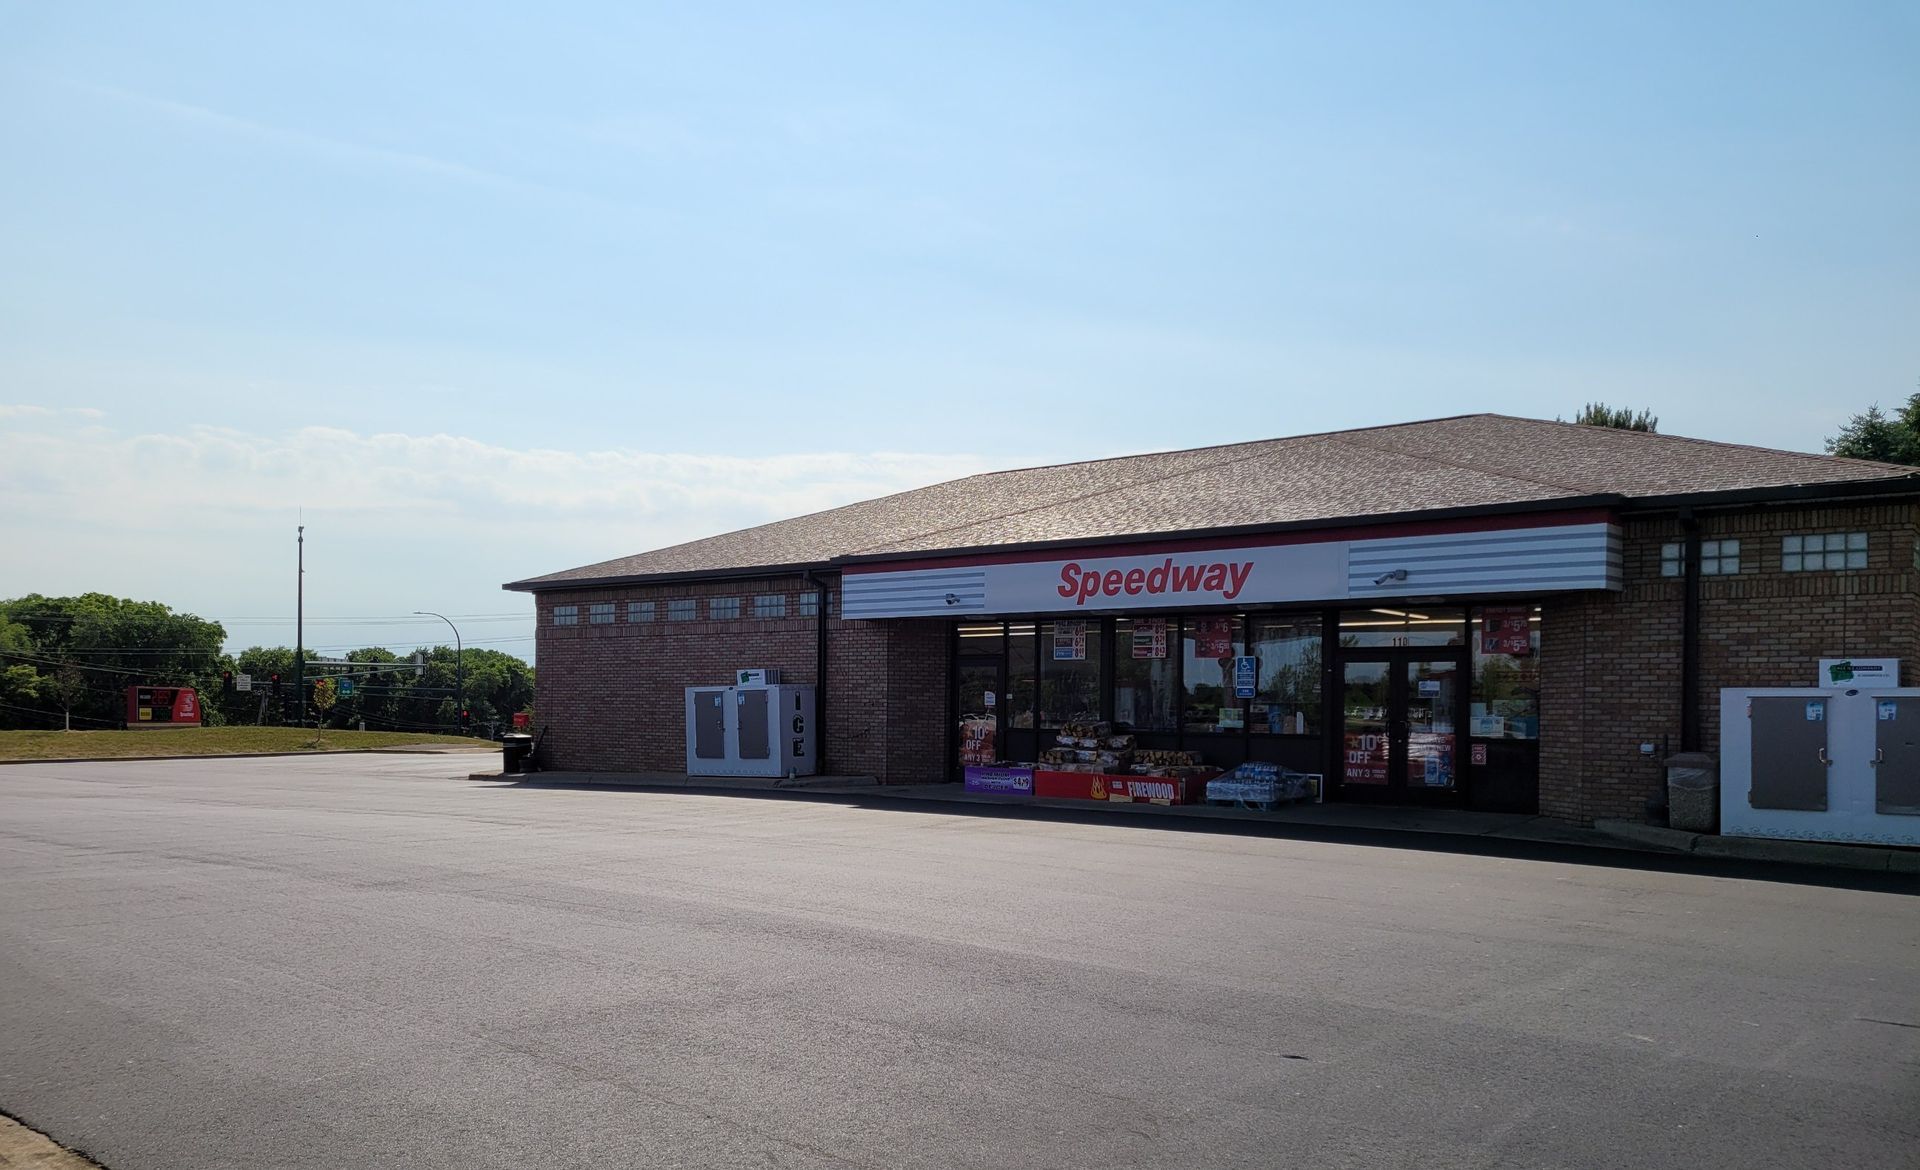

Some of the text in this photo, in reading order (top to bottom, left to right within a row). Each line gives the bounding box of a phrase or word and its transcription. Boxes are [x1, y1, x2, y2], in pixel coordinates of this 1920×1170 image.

[1057, 558, 1254, 605] Speedway
[792, 691, 804, 757] ICE
[966, 740, 981, 750] OFF
[964, 754, 976, 762] ANY
[1349, 751, 1371, 764] OFF
[1347, 768, 1363, 777] ANY
[1364, 769, 1370, 778] 3
[1127, 781, 1175, 800] FIREWOOD
